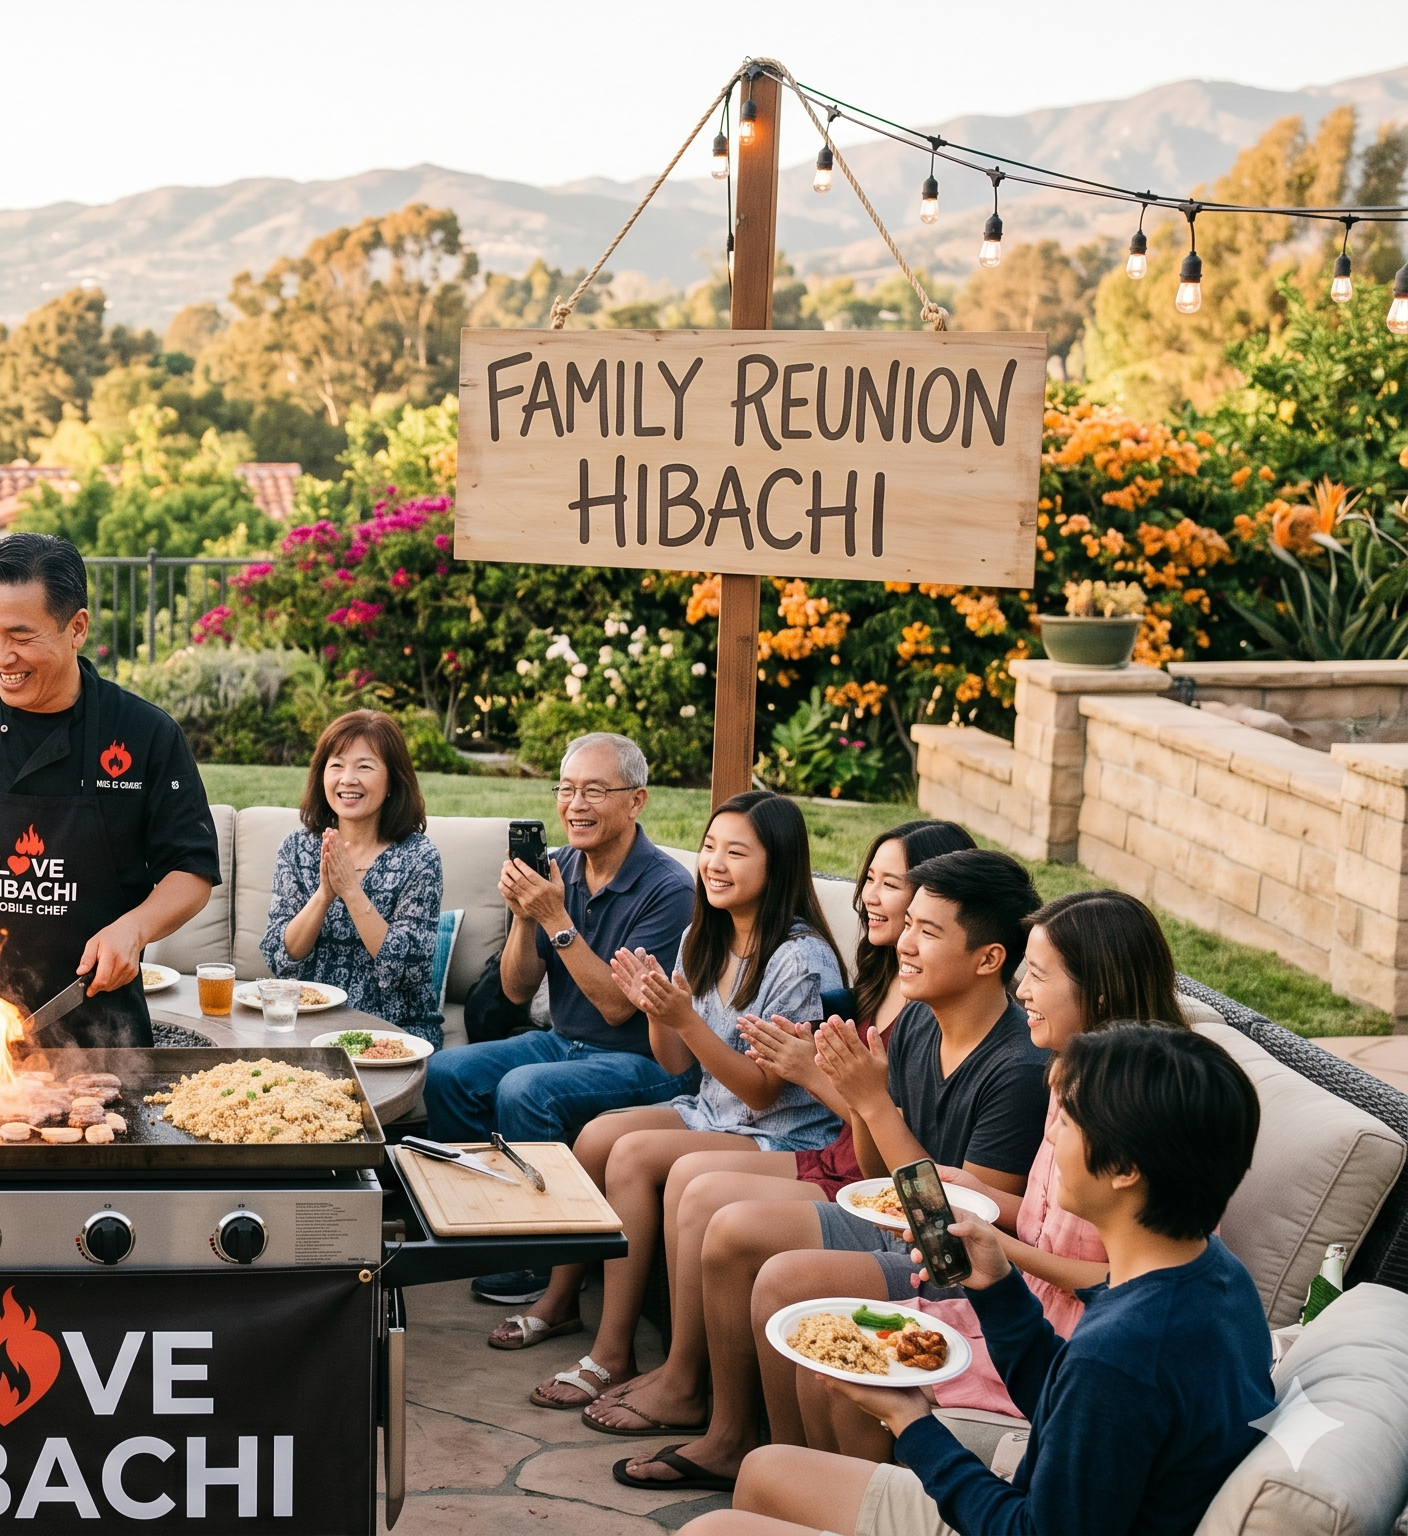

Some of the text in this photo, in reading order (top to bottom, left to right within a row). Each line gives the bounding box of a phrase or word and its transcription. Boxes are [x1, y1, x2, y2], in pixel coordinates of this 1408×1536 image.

[487, 351, 1018, 451] FAMILY REUNION
[568, 454, 886, 558] HIBACHI
[36, 904, 68, 916] CHEF
